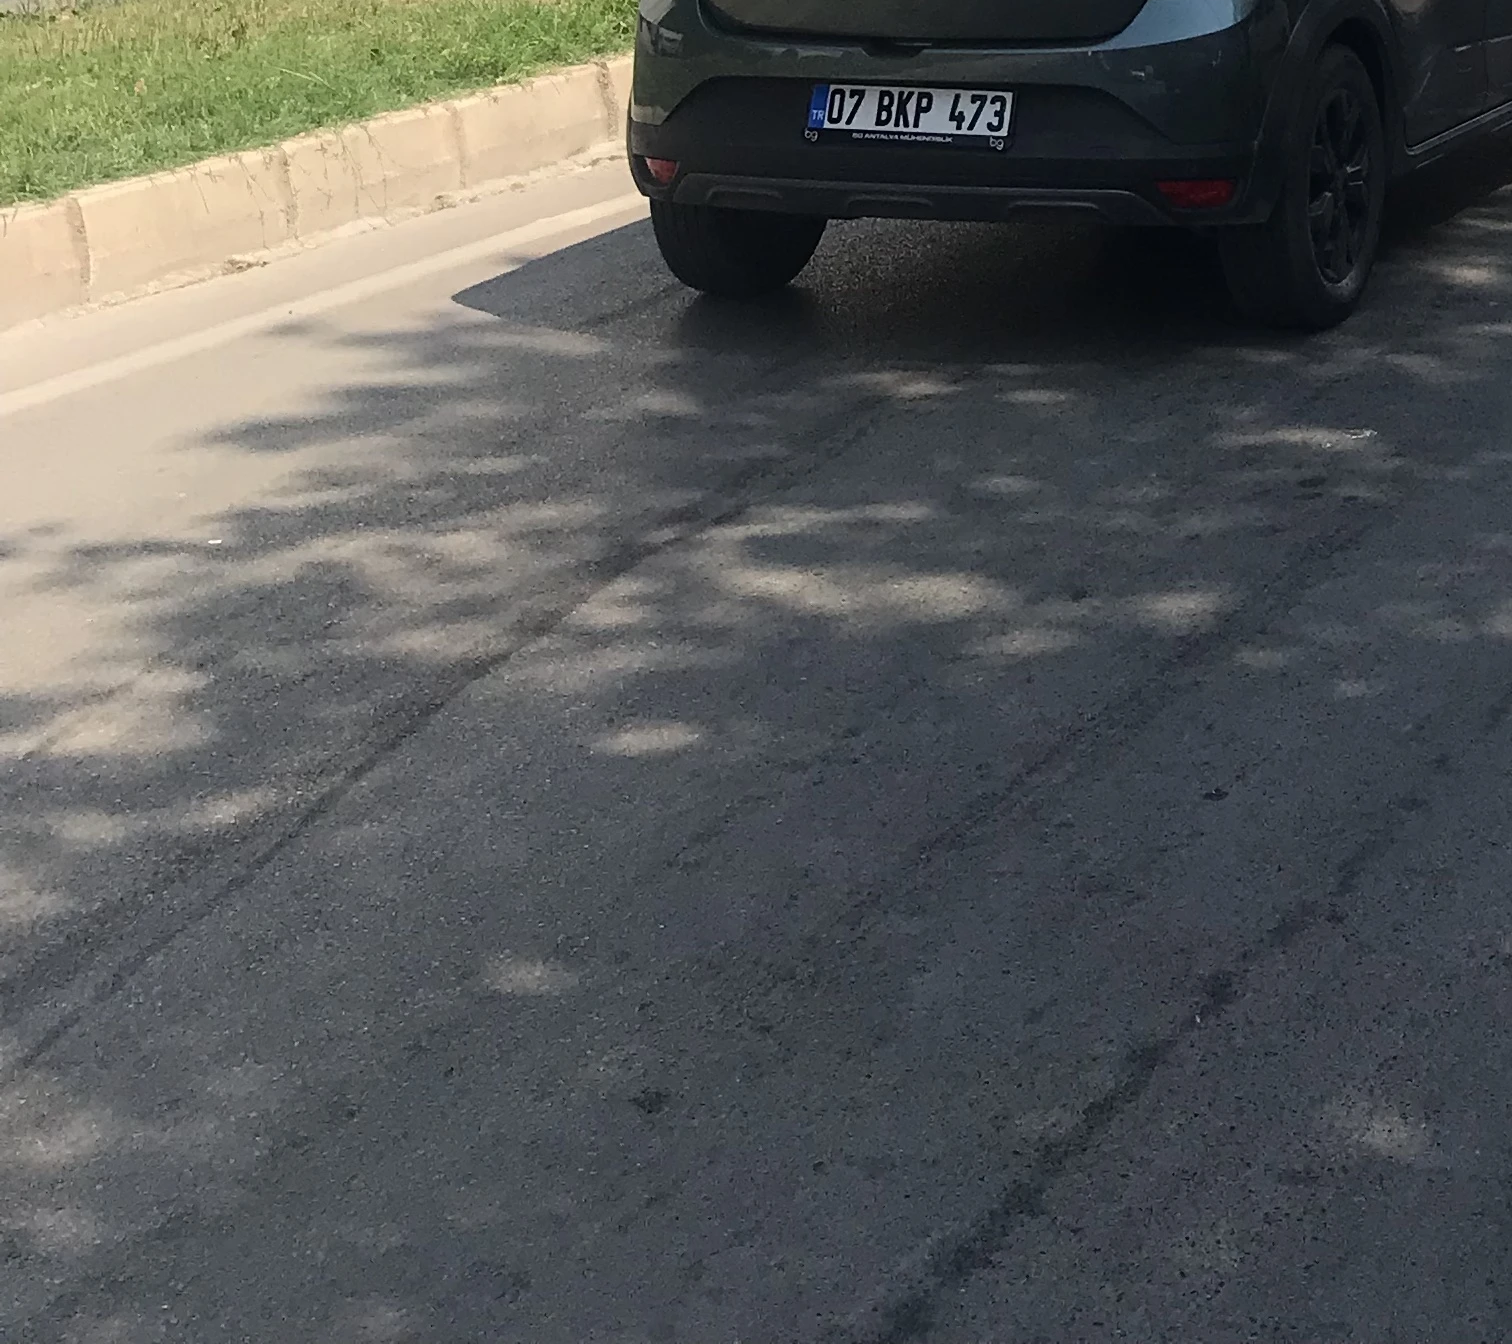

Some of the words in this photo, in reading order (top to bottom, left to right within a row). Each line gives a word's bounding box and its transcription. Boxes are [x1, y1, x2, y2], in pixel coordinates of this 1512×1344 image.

[811, 109, 825, 121] TR
[826, 87, 867, 126] 07
[874, 89, 934, 129] BKP
[948, 92, 1008, 133] 473
[864, 132, 900, 141] ANTALYA
